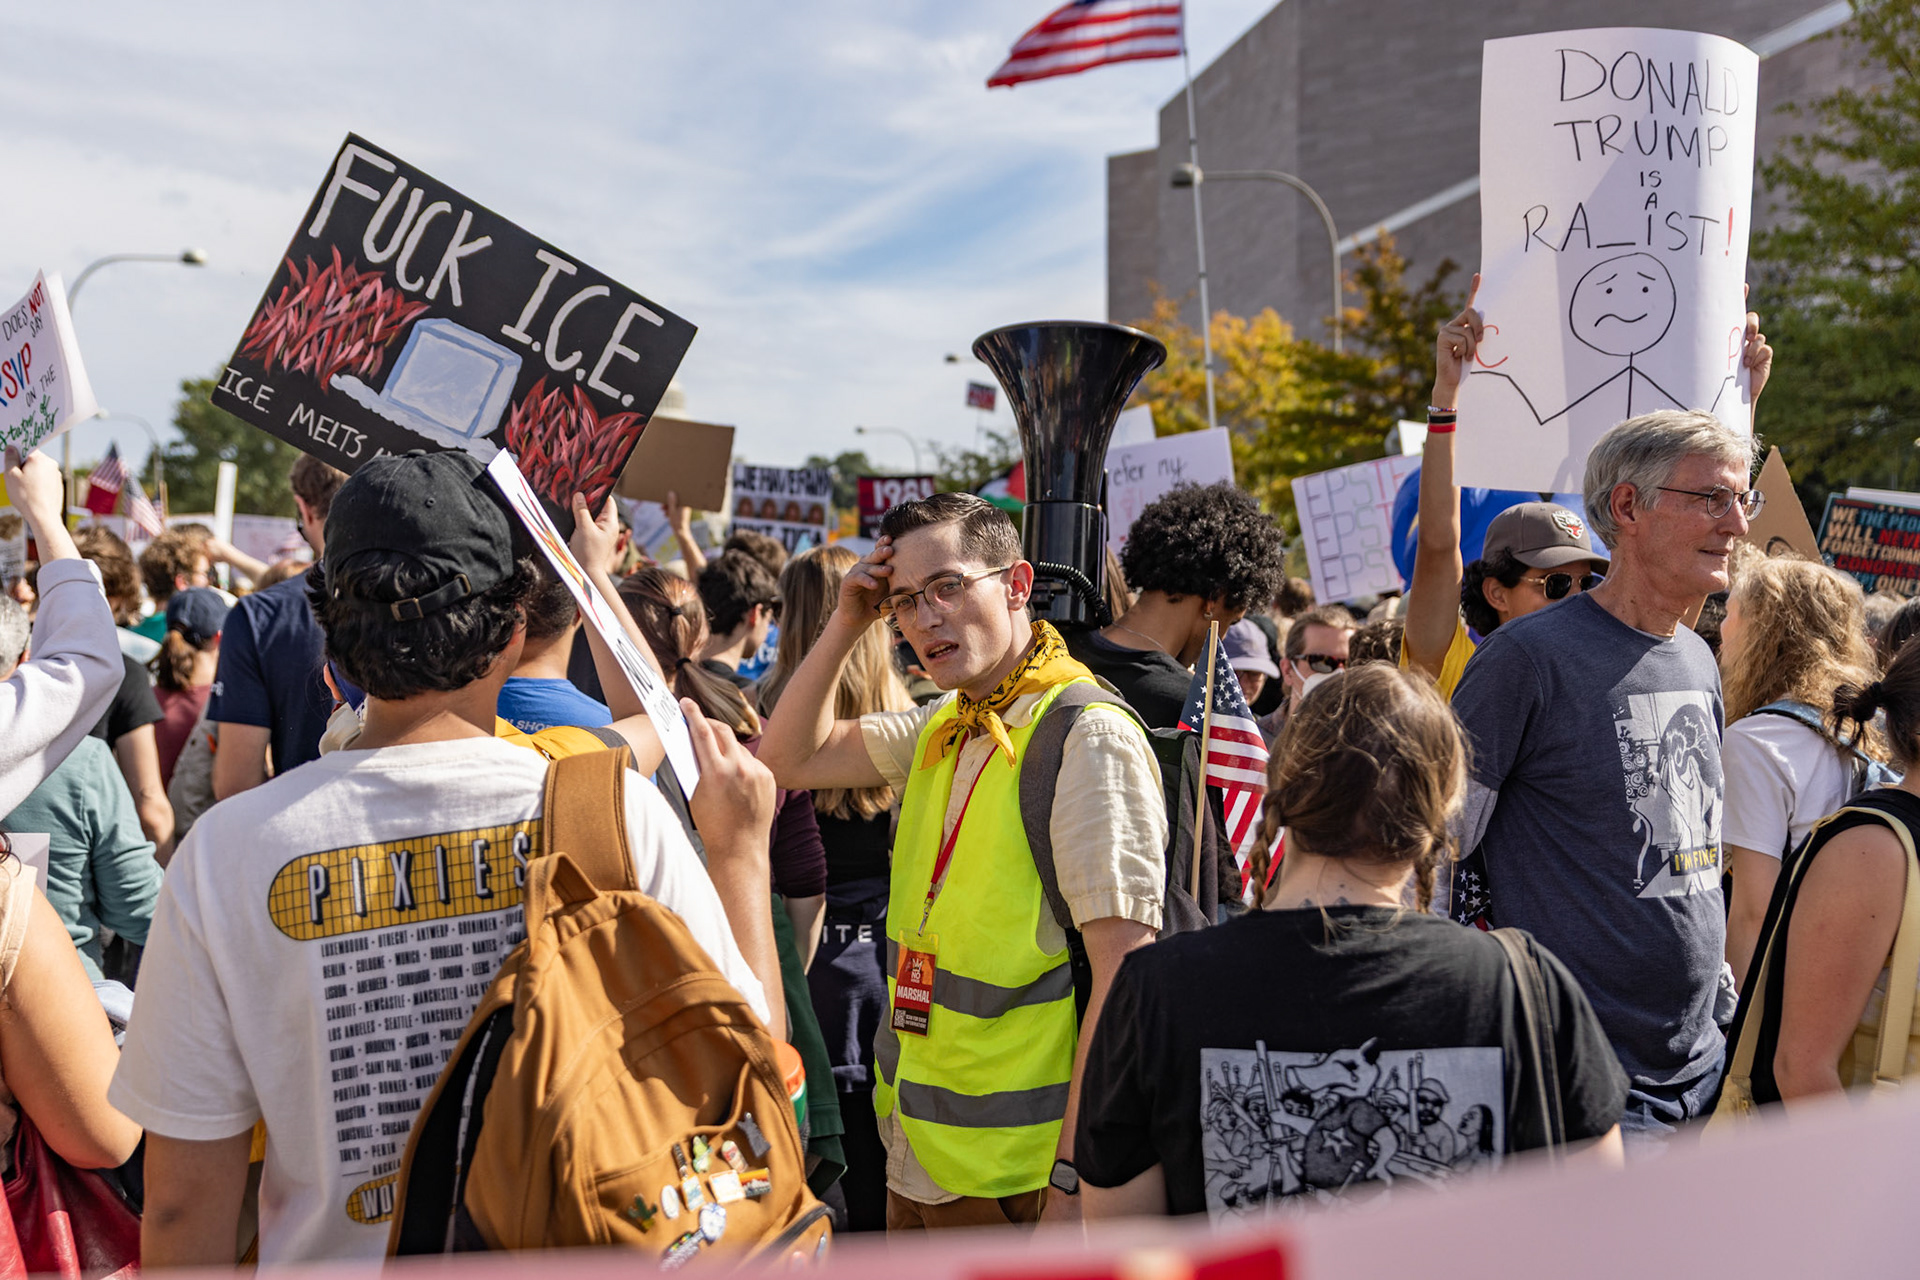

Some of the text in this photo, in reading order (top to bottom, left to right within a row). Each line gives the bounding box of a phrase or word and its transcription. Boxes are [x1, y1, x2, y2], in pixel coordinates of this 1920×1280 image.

[1555, 48, 1740, 116] DONALD
[1553, 113, 1729, 168] TRUMP
[1639, 170, 1663, 188] IS
[1644, 191, 1659, 211] A
[307, 141, 666, 408] FUCK I.C.E.
[2, 280, 46, 342] DOES NOT
[29, 311, 44, 338] SAY
[1728, 326, 1743, 371] P
[25, 363, 57, 408] ON THE
[217, 366, 369, 460] I.C.E. MELTS
[1828, 522, 1873, 542] WILL
[1831, 505, 1920, 533] WE THE PEO
[1821, 537, 1880, 558] FORGET
[1320, 545, 1404, 600] EPS
[307, 831, 531, 926] PIXIES
[1693, 848, 1717, 868] FINE
[896, 984, 930, 1004] MARSHAL
